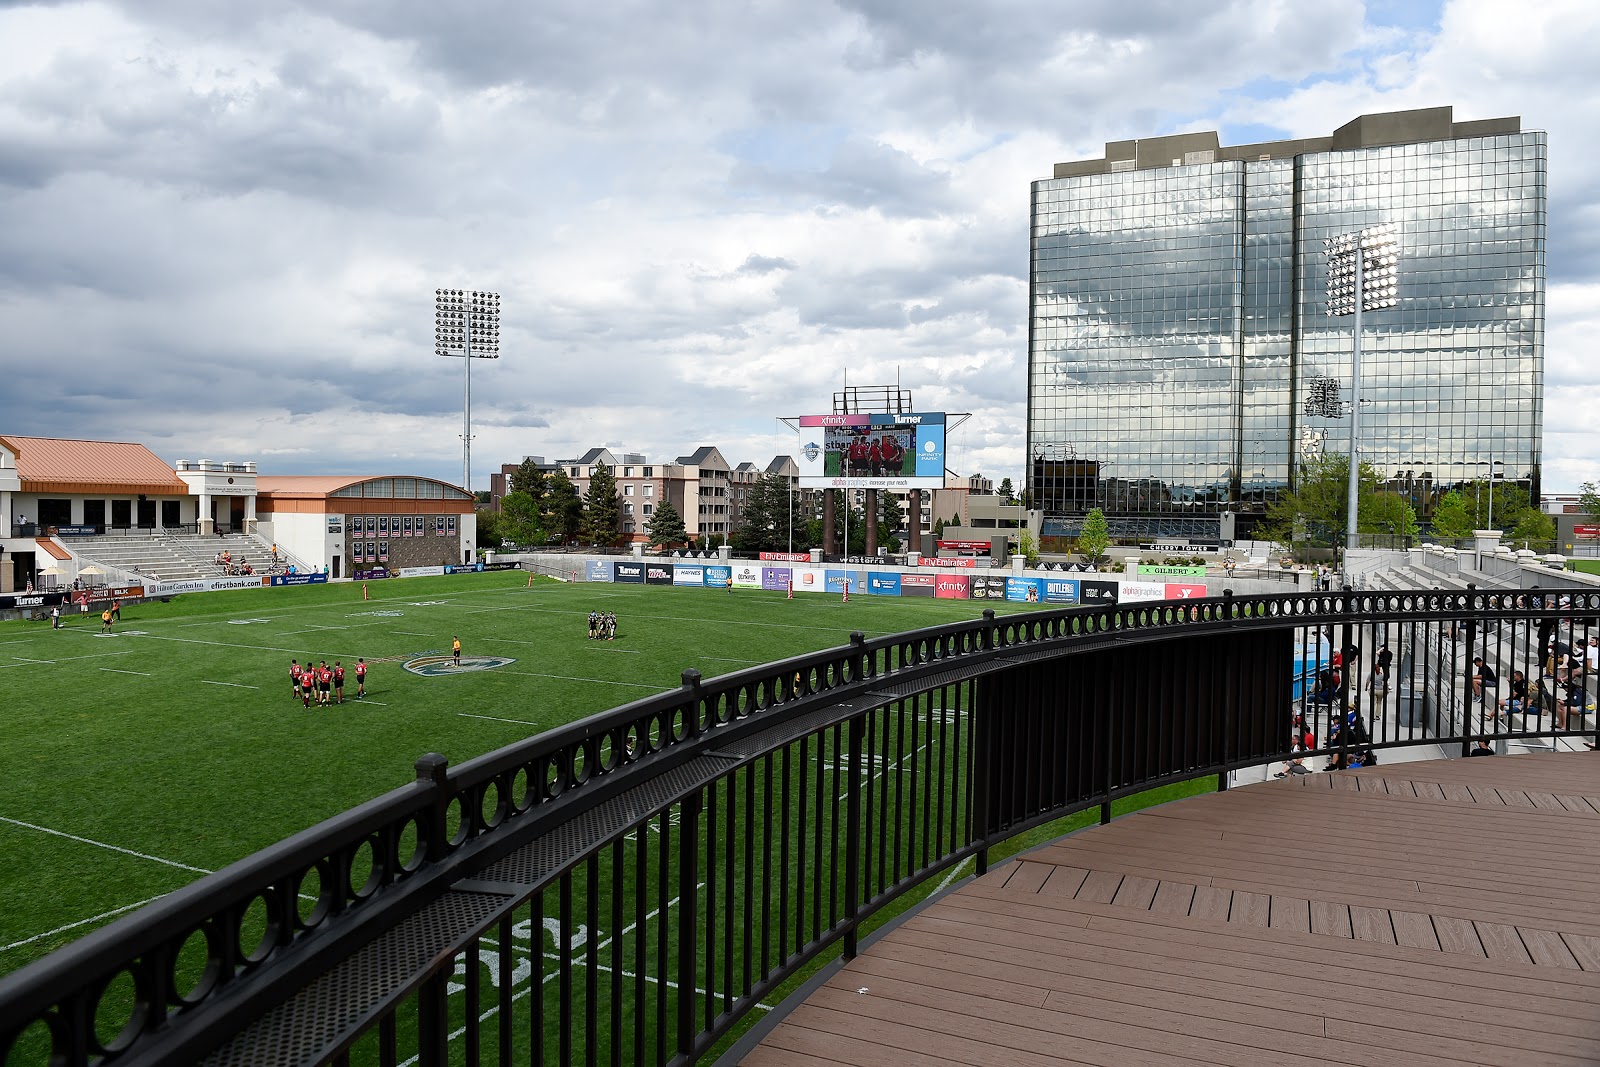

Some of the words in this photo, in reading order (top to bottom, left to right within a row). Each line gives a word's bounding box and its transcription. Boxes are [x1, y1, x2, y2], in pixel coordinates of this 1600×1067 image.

[892, 414, 922, 423] Turner
[776, 553, 805, 561] Emiates
[924, 558, 936, 566] Fly
[936, 558, 968, 566] Emirates
[618, 566, 640, 574] Turner
[211, 581, 260, 589] efirstbank.com
[1048, 583, 1069, 593] BUTLER
[1122, 586, 1162, 596] alphagraphics
[14, 596, 44, 605] Turner
